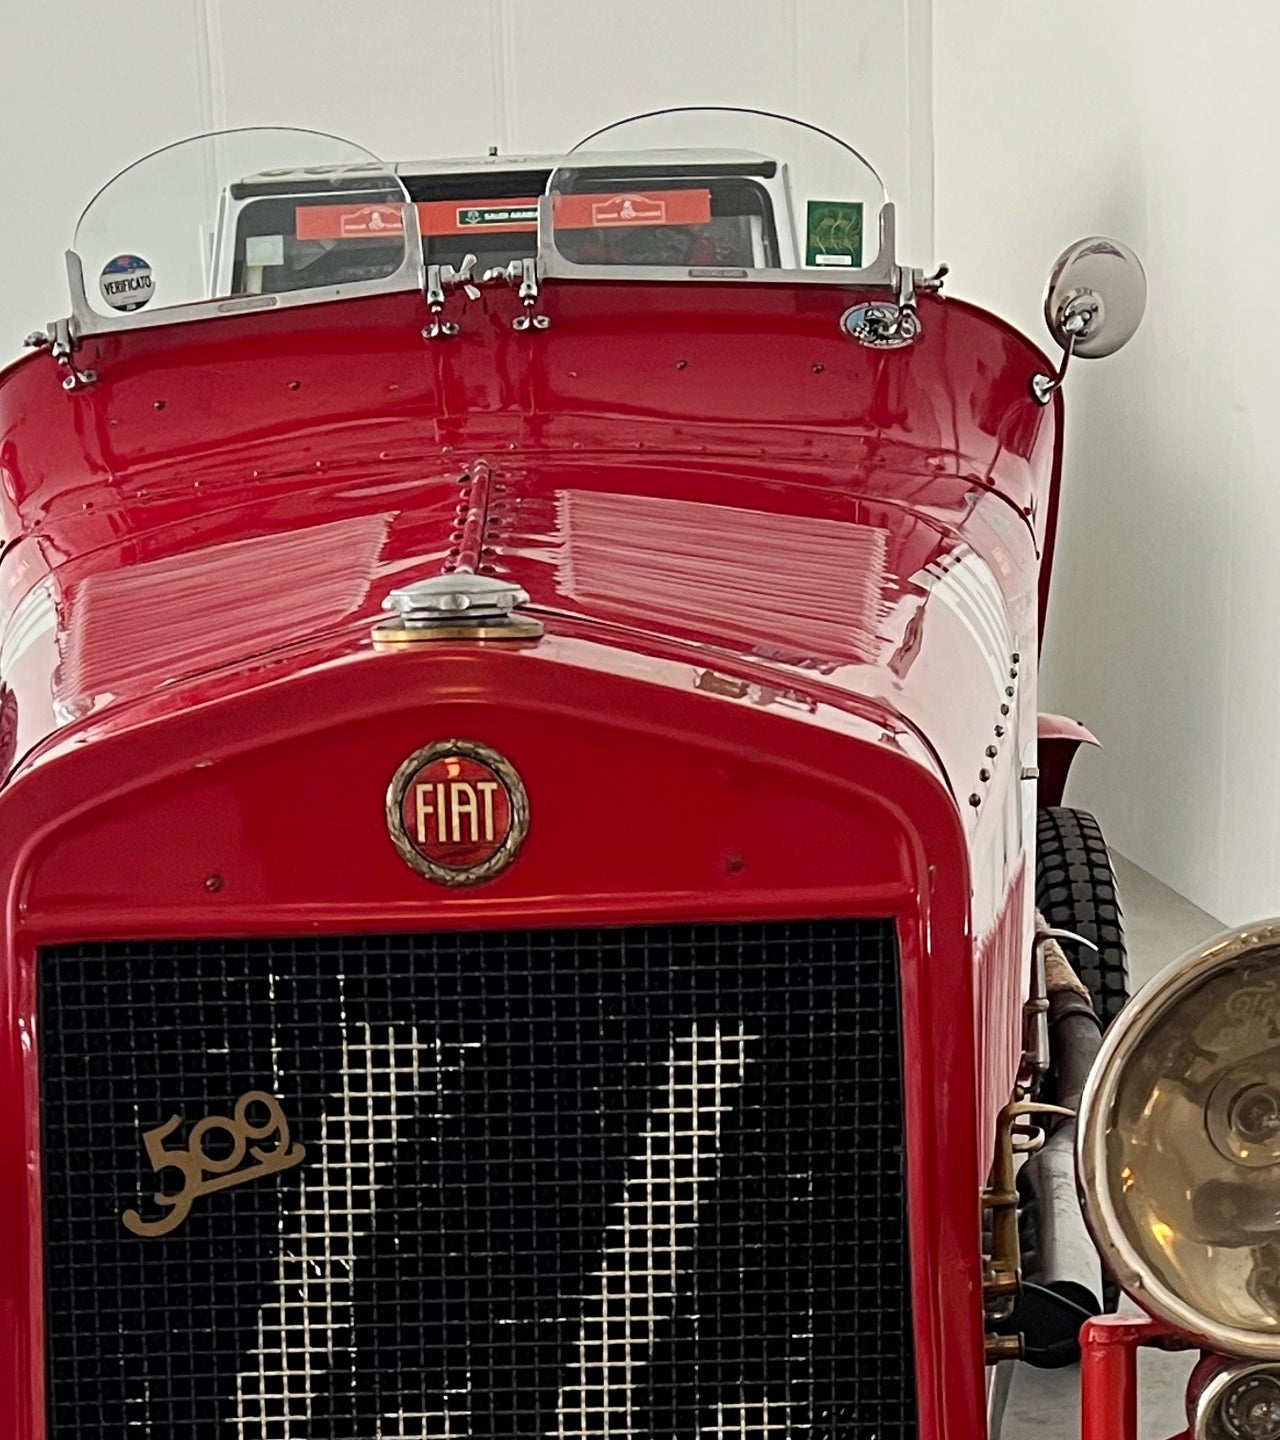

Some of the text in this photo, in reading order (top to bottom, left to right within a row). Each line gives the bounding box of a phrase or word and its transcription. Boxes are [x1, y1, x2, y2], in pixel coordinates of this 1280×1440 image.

[104, 275, 151, 295] VERIFICATO
[416, 781, 498, 843] FIAT
[122, 1090, 306, 1237] 509
